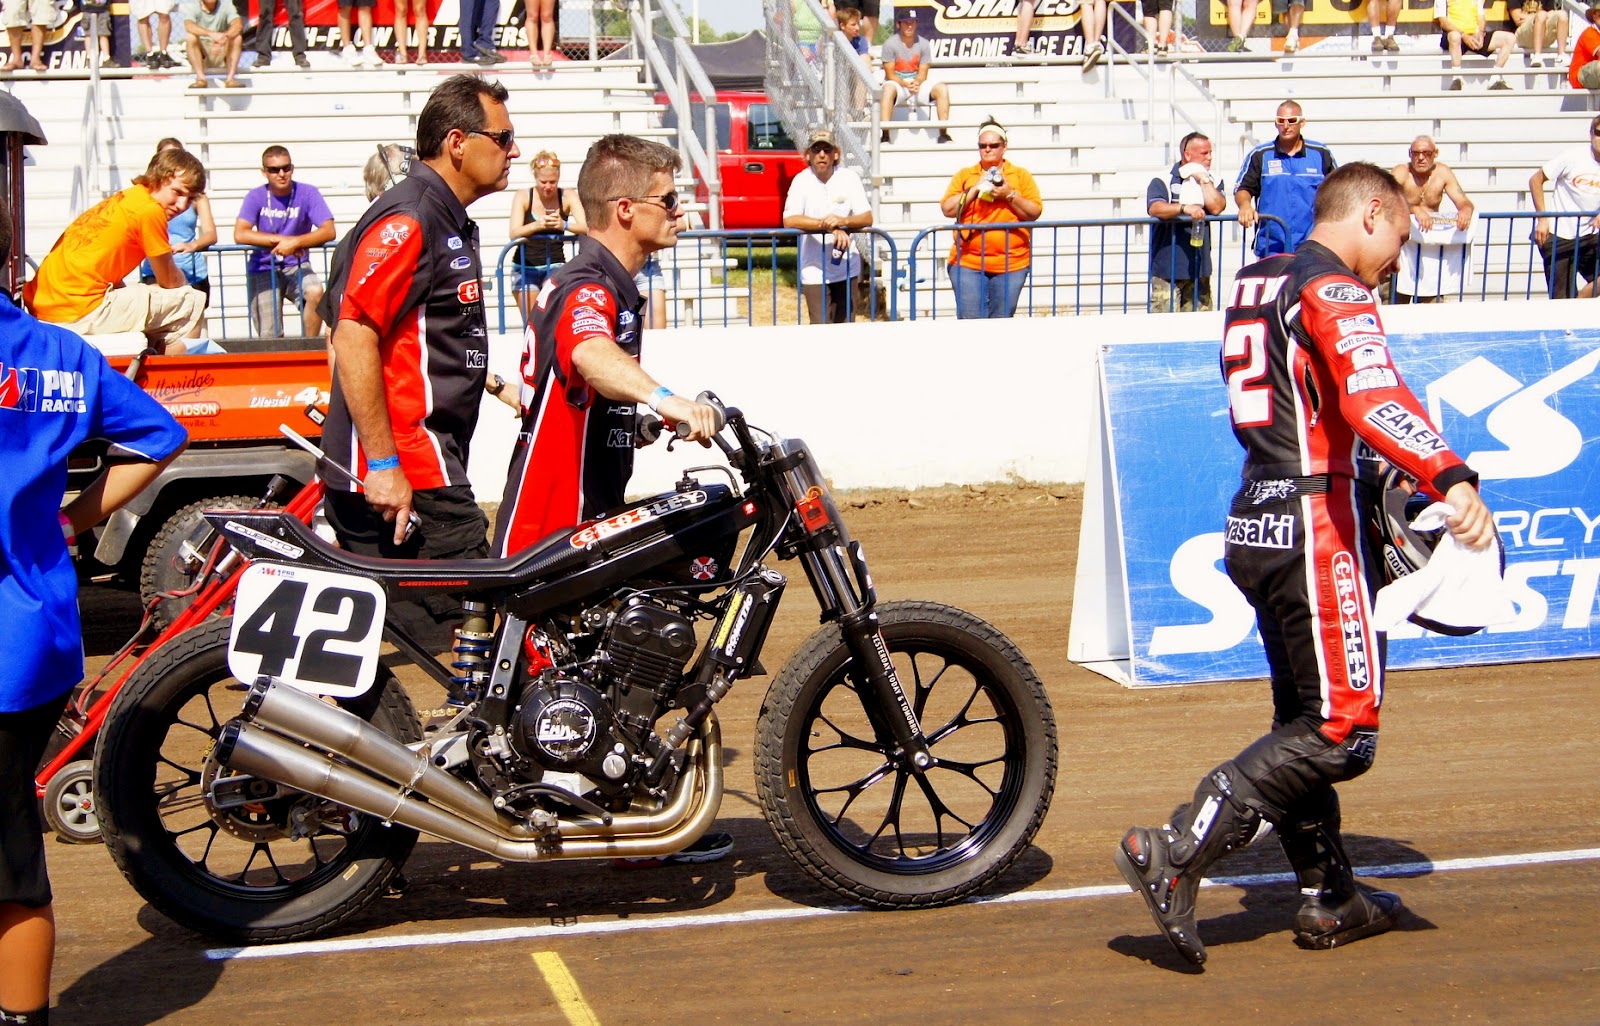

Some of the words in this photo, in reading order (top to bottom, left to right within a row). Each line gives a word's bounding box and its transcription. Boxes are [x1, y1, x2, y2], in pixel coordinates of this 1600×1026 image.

[442, 26, 530, 48] FIERS
[1022, 35, 1060, 57] ACE
[1062, 35, 1109, 57] FAS
[48, 50, 92, 70] FAN
[1224, 320, 1270, 425] 2
[41, 399, 87, 413] RACG
[1374, 403, 1446, 451] EAKEN
[689, 563, 719, 574] GUTS
[233, 579, 377, 688] 42
